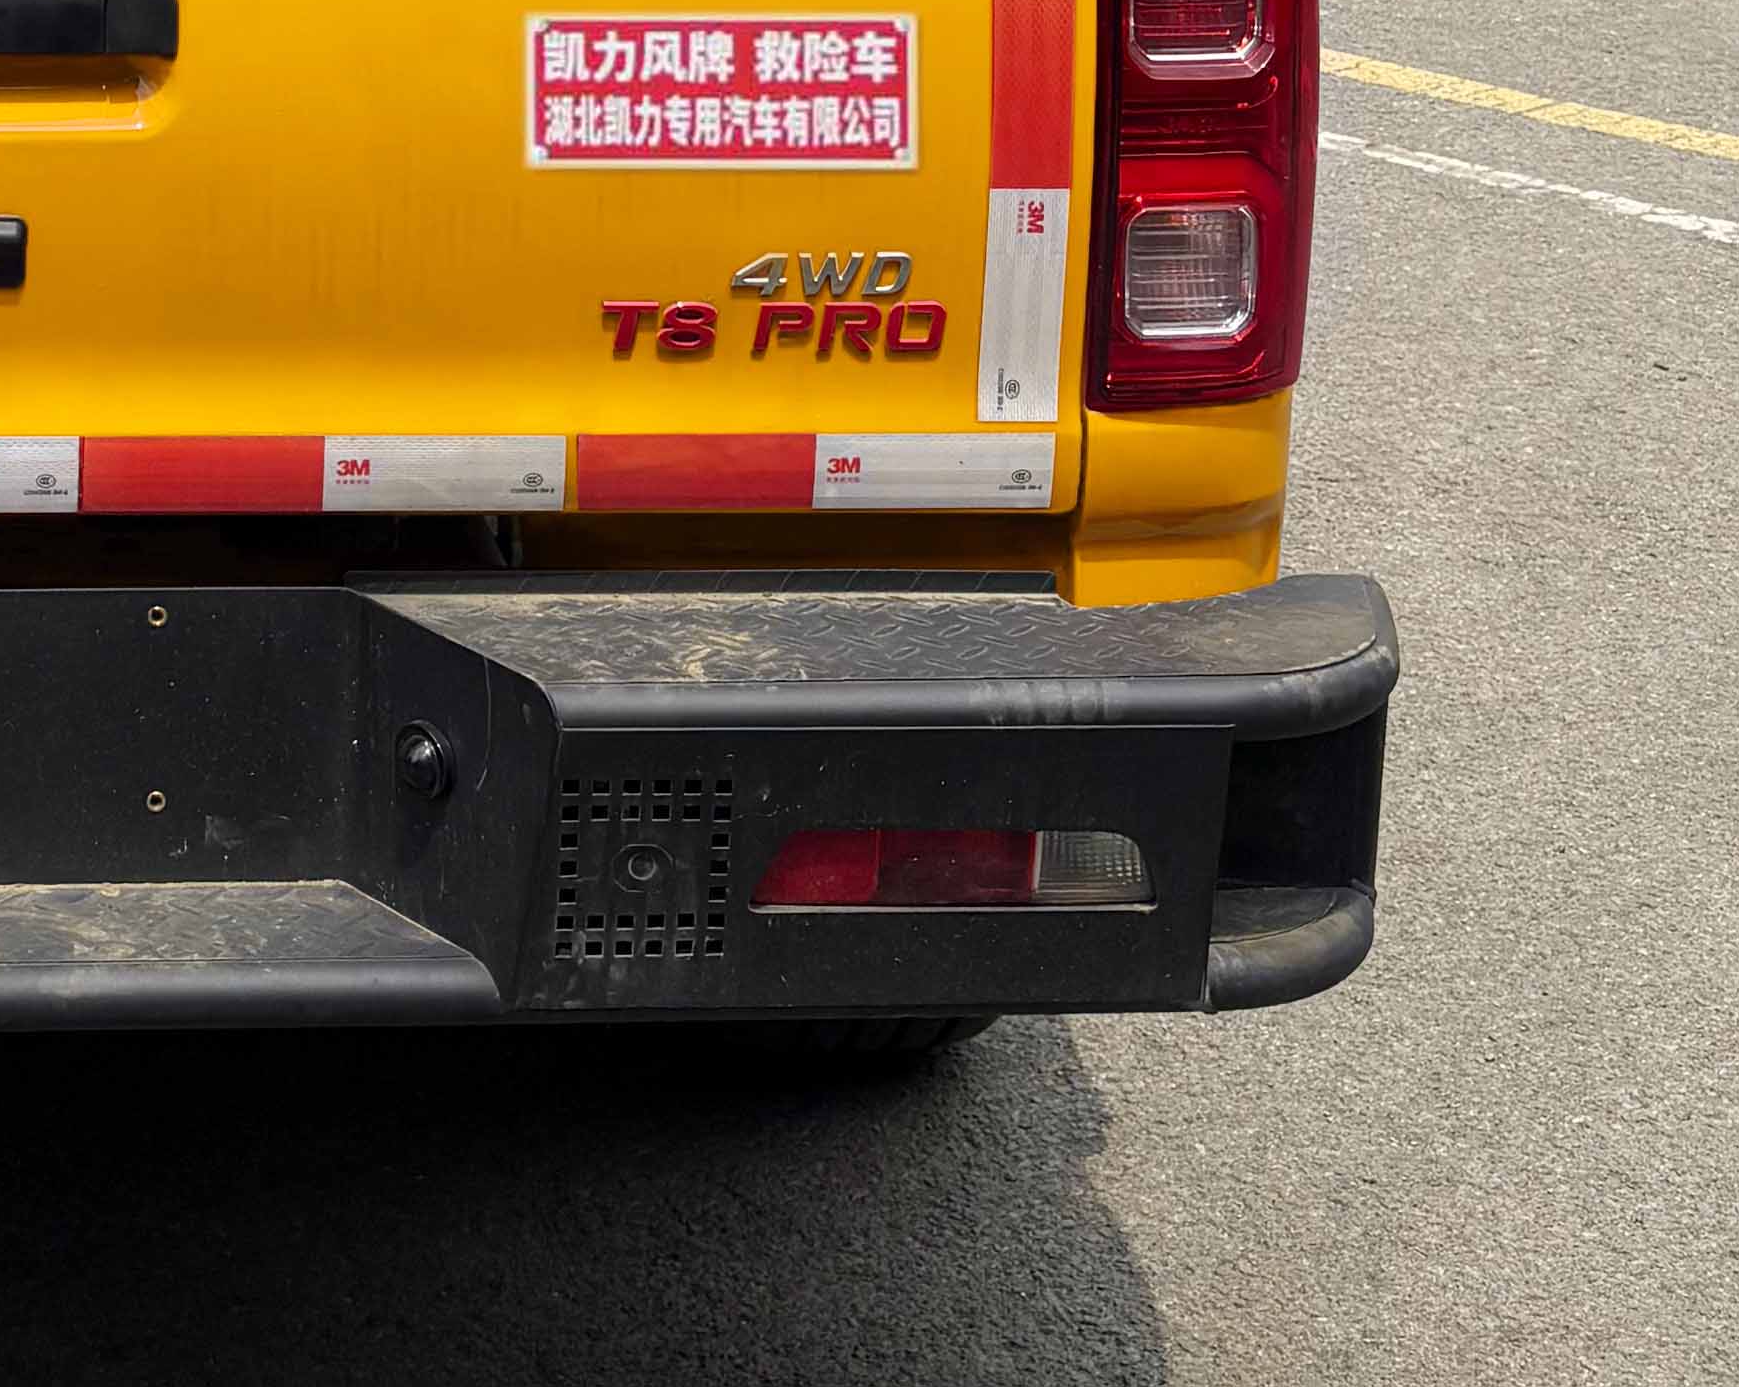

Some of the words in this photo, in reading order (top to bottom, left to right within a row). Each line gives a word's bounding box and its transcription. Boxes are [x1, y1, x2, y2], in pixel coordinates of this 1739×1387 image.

[543, 30, 736, 84] 凯力风牌
[753, 29, 898, 84] 救险车
[544, 94, 902, 147] 湖北凯力专用汽车有限公司
[1026, 200, 1045, 236] 3M
[731, 251, 913, 296] 4WD
[603, 301, 718, 352] T8
[753, 300, 947, 353] PRO
[337, 459, 371, 476] 3M
[827, 458, 861, 475] 3M
